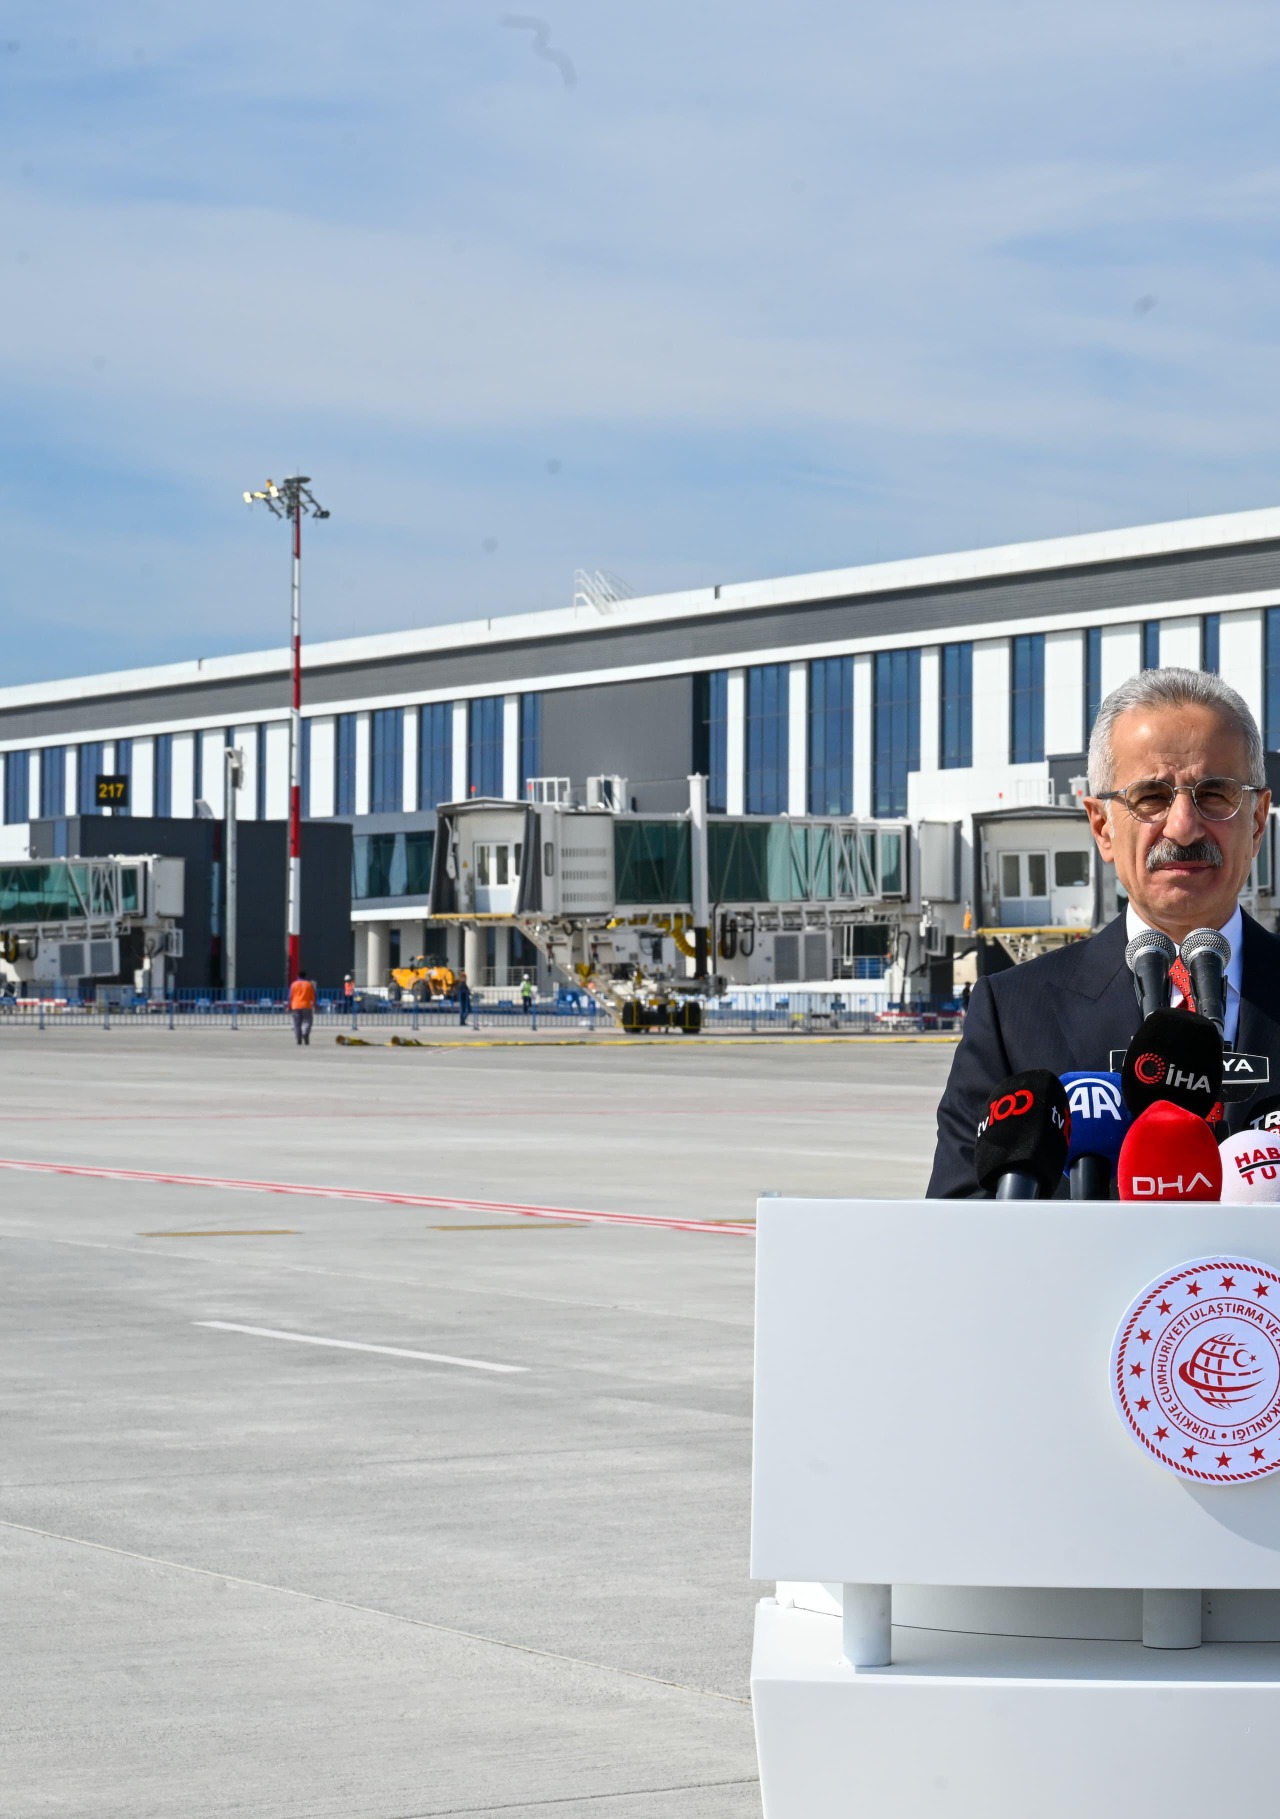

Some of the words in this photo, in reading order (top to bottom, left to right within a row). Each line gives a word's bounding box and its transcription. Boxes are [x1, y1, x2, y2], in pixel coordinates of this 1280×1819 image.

[98, 783, 125, 798] 217
[1069, 1086, 1122, 1120] AA
[1132, 1172, 1213, 1196] DHA
[1189, 1302, 1265, 1324] ULAŞTIRMA
[1265, 1319, 1280, 1337] VE
[1156, 1315, 1191, 1404] CUMHURİYETİ
[1167, 1403, 1216, 1441] TÜRKİYE
